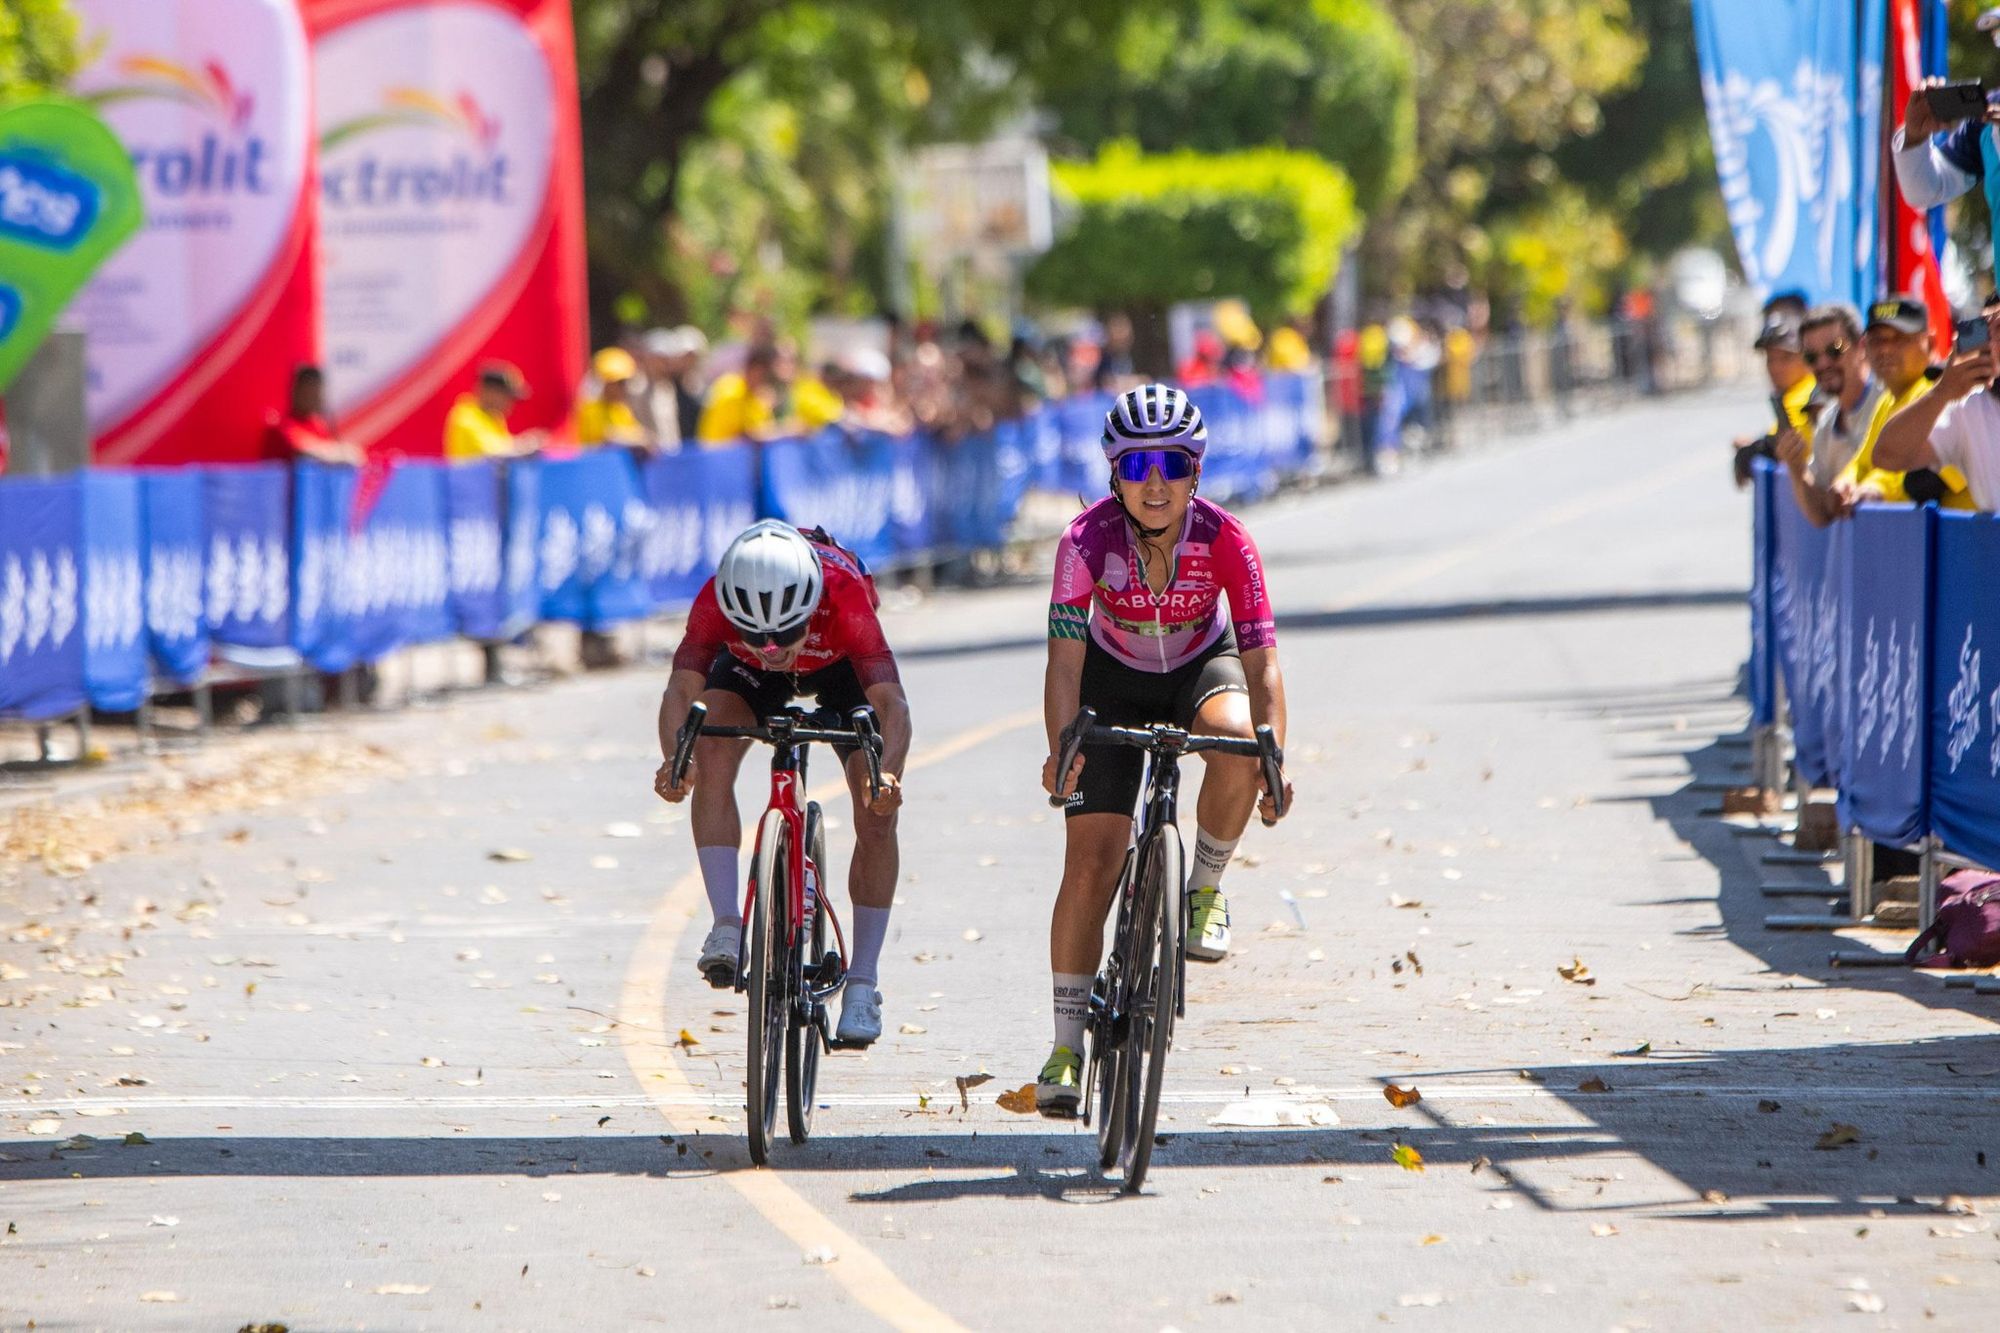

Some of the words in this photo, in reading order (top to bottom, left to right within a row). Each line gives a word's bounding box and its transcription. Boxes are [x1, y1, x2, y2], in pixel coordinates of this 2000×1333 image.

[1062, 543, 1083, 599] LABORAL
[1240, 545, 1264, 607] LABORAL
[1104, 592, 1212, 608] LABORAL
